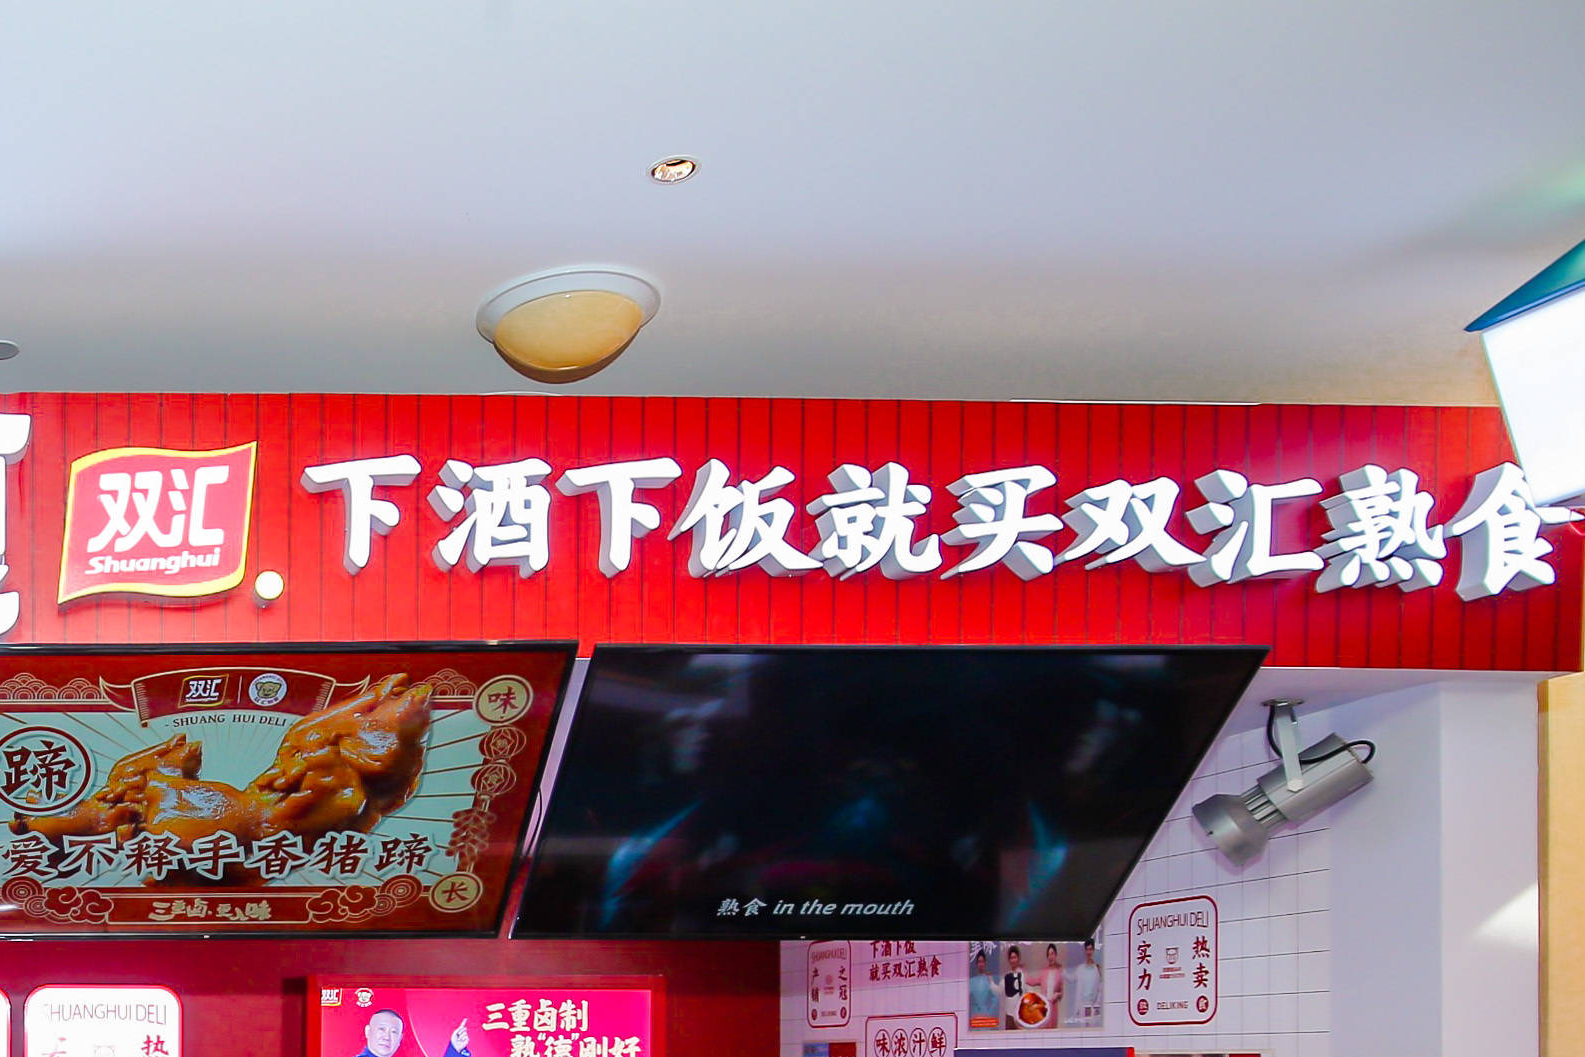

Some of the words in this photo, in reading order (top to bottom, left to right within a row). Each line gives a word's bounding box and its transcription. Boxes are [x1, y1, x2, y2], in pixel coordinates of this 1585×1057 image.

[86, 465, 230, 553] 双汇
[302, 455, 1564, 601] 下酒下饭就买双汇熟食
[84, 546, 220, 576] Shuanghui
[185, 679, 223, 698] 双汇
[487, 685, 518, 715] 味
[173, 713, 226, 728] SHUANG
[232, 713, 255, 723] HUI
[258, 715, 287, 727] DELI
[3, 740, 78, 802] 蹄
[0, 833, 434, 878] 爱不释手香猪蹄
[442, 881, 468, 904] 长
[716, 898, 767, 917] 熟食
[773, 900, 795, 915] in
[800, 899, 837, 915] the
[840, 899, 915, 915] mouth
[1137, 913, 1188, 935] SHUANGHUI
[1190, 910, 1209, 928] DELI
[869, 955, 942, 981] 就买双汇熟食
[1137, 941, 1152, 990] 实力
[1192, 936, 1210, 988] 热卖
[45, 1003, 132, 1022] HUANGHUI
[136, 1004, 166, 1026] DELI
[482, 999, 589, 1032] 三重卤制
[875, 1030, 947, 1057] 味浓汁鲜
